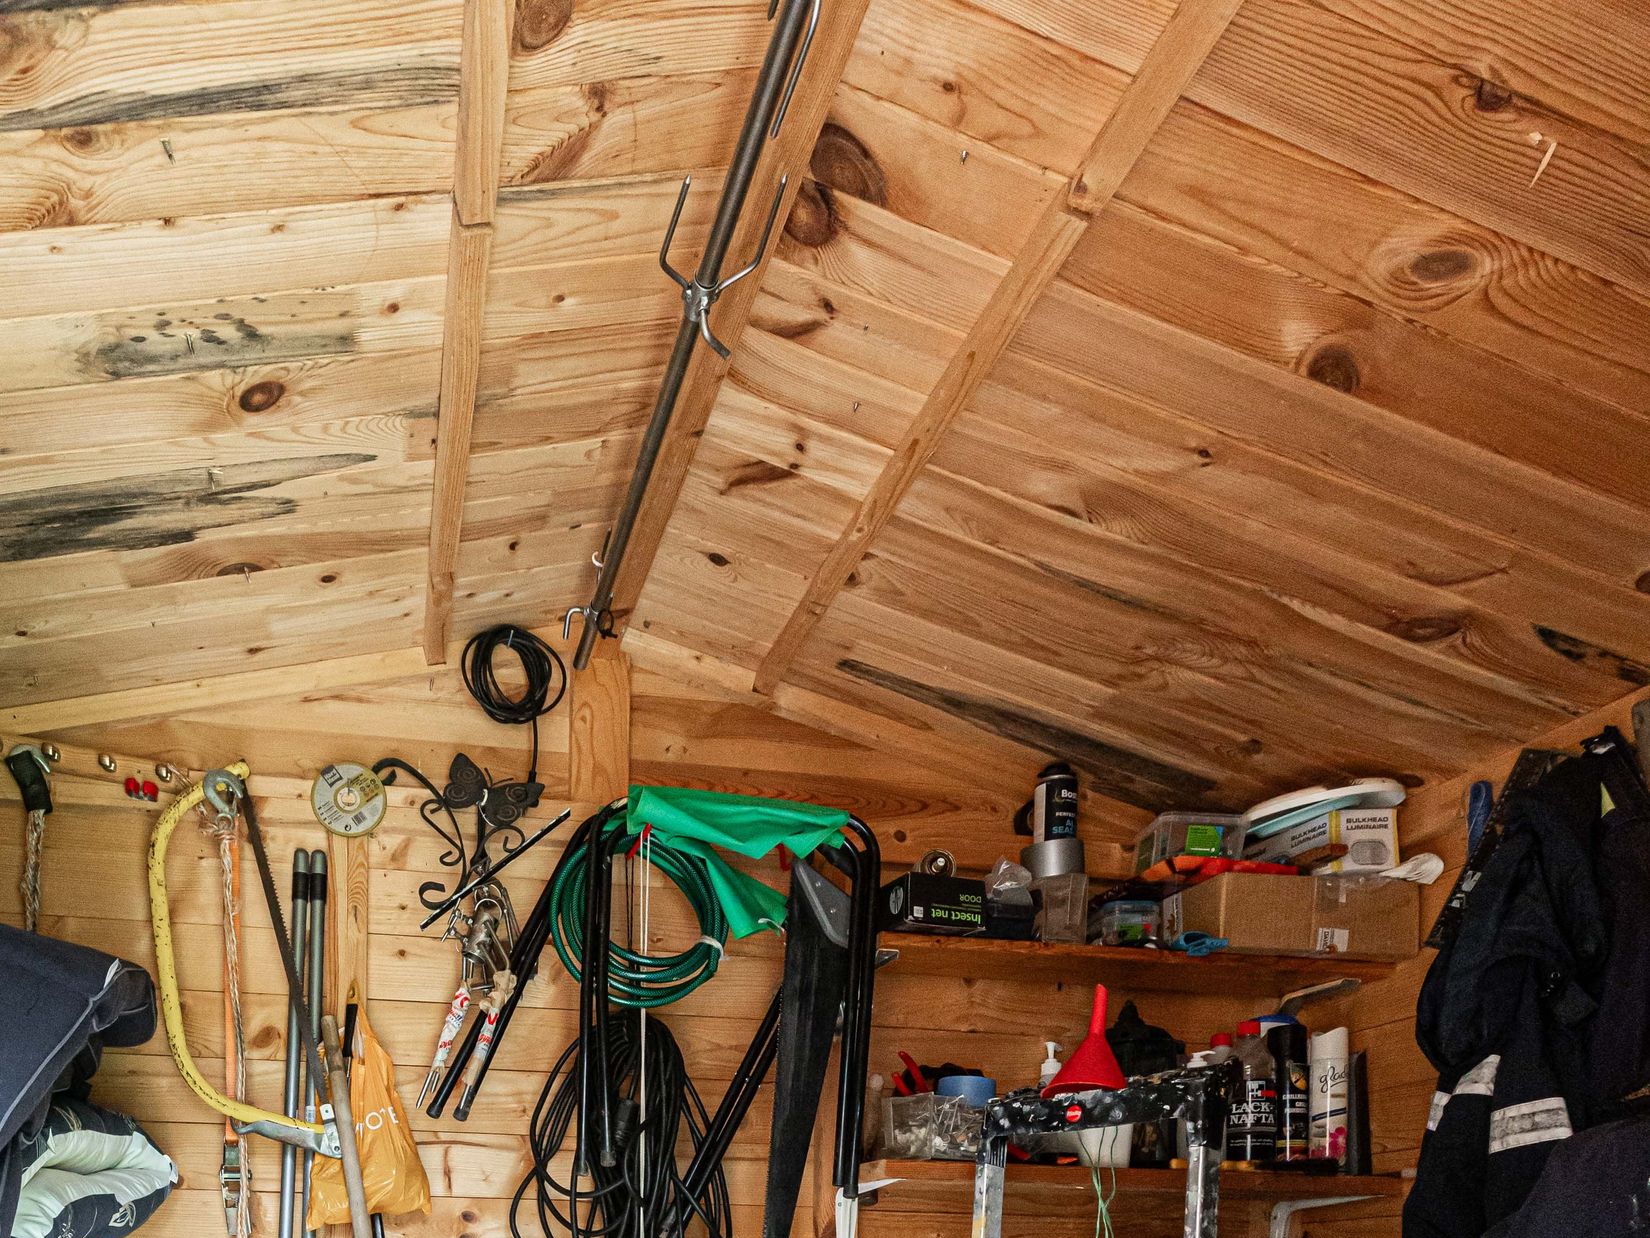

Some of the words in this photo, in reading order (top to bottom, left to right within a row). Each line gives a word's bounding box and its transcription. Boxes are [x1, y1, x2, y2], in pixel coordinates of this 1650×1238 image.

[1345, 816, 1389, 824] BULKHEAD
[1290, 822, 1328, 841] BULKHEAD
[1345, 823, 1389, 831] LUMINAIRE
[1290, 830, 1328, 848] LUMINAIRE
[959, 893, 982, 903] DOOR
[931, 908, 949, 918] net
[951, 910, 982, 924] Insect
[1231, 1102, 1273, 1114] LACK-
[1229, 1113, 1275, 1125] NAFTA
